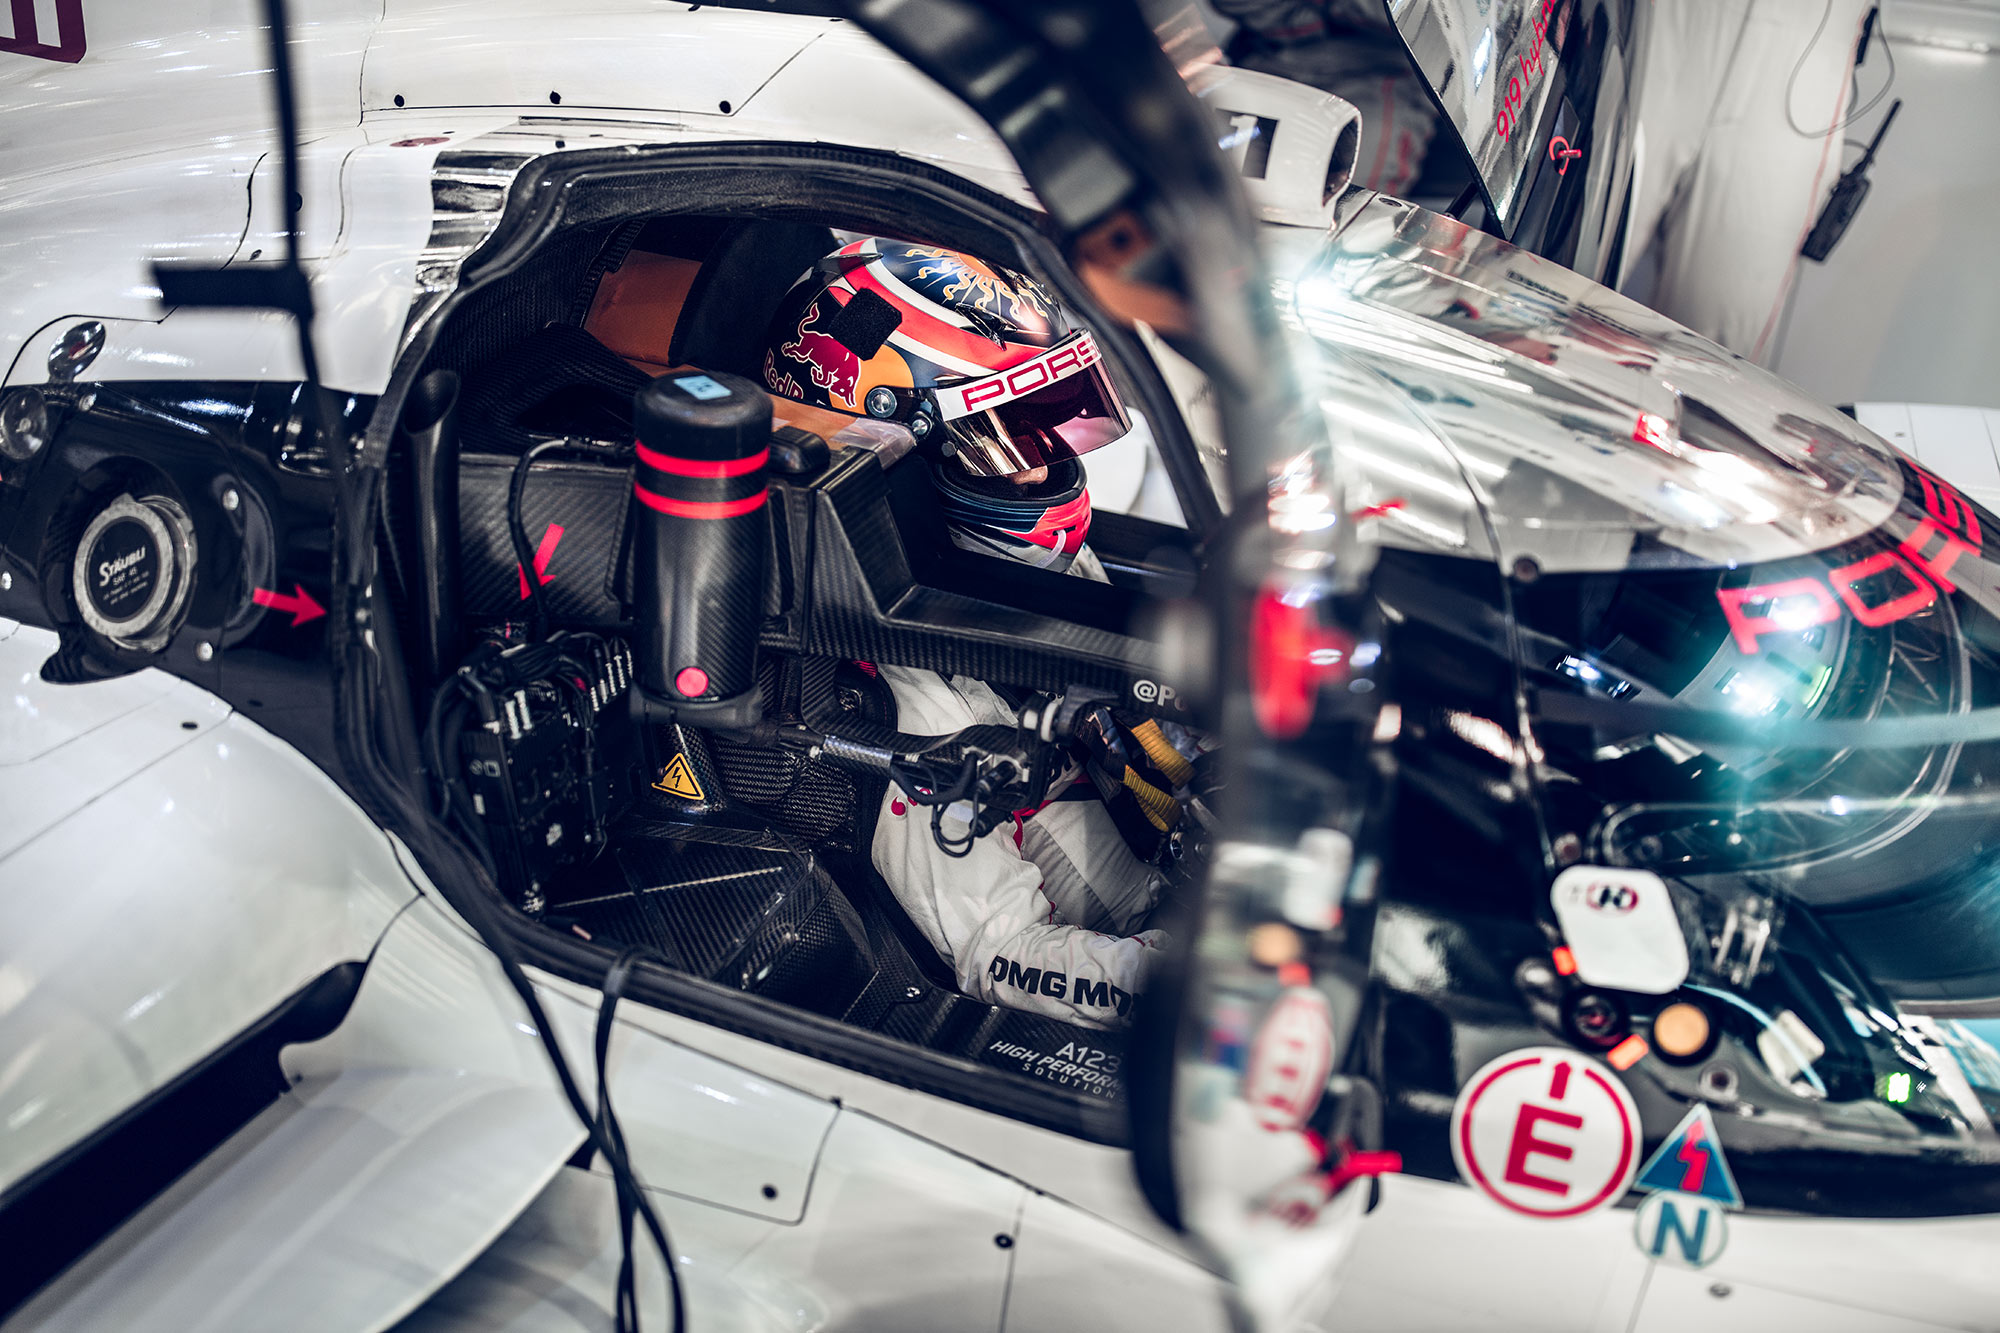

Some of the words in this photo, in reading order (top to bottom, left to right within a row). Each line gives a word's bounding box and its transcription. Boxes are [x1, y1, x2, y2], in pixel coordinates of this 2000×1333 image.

[1497, 77, 1521, 142] 919
[961, 334, 1097, 412] PORS
[989, 954, 1067, 999] DMG
[990, 1040, 1040, 1062] HIGH
[1056, 1041, 1121, 1073] A123
[1022, 1062, 1117, 1099] SOLUTION
[1503, 1102, 1584, 1198] E
[1650, 1199, 1709, 1263] N
